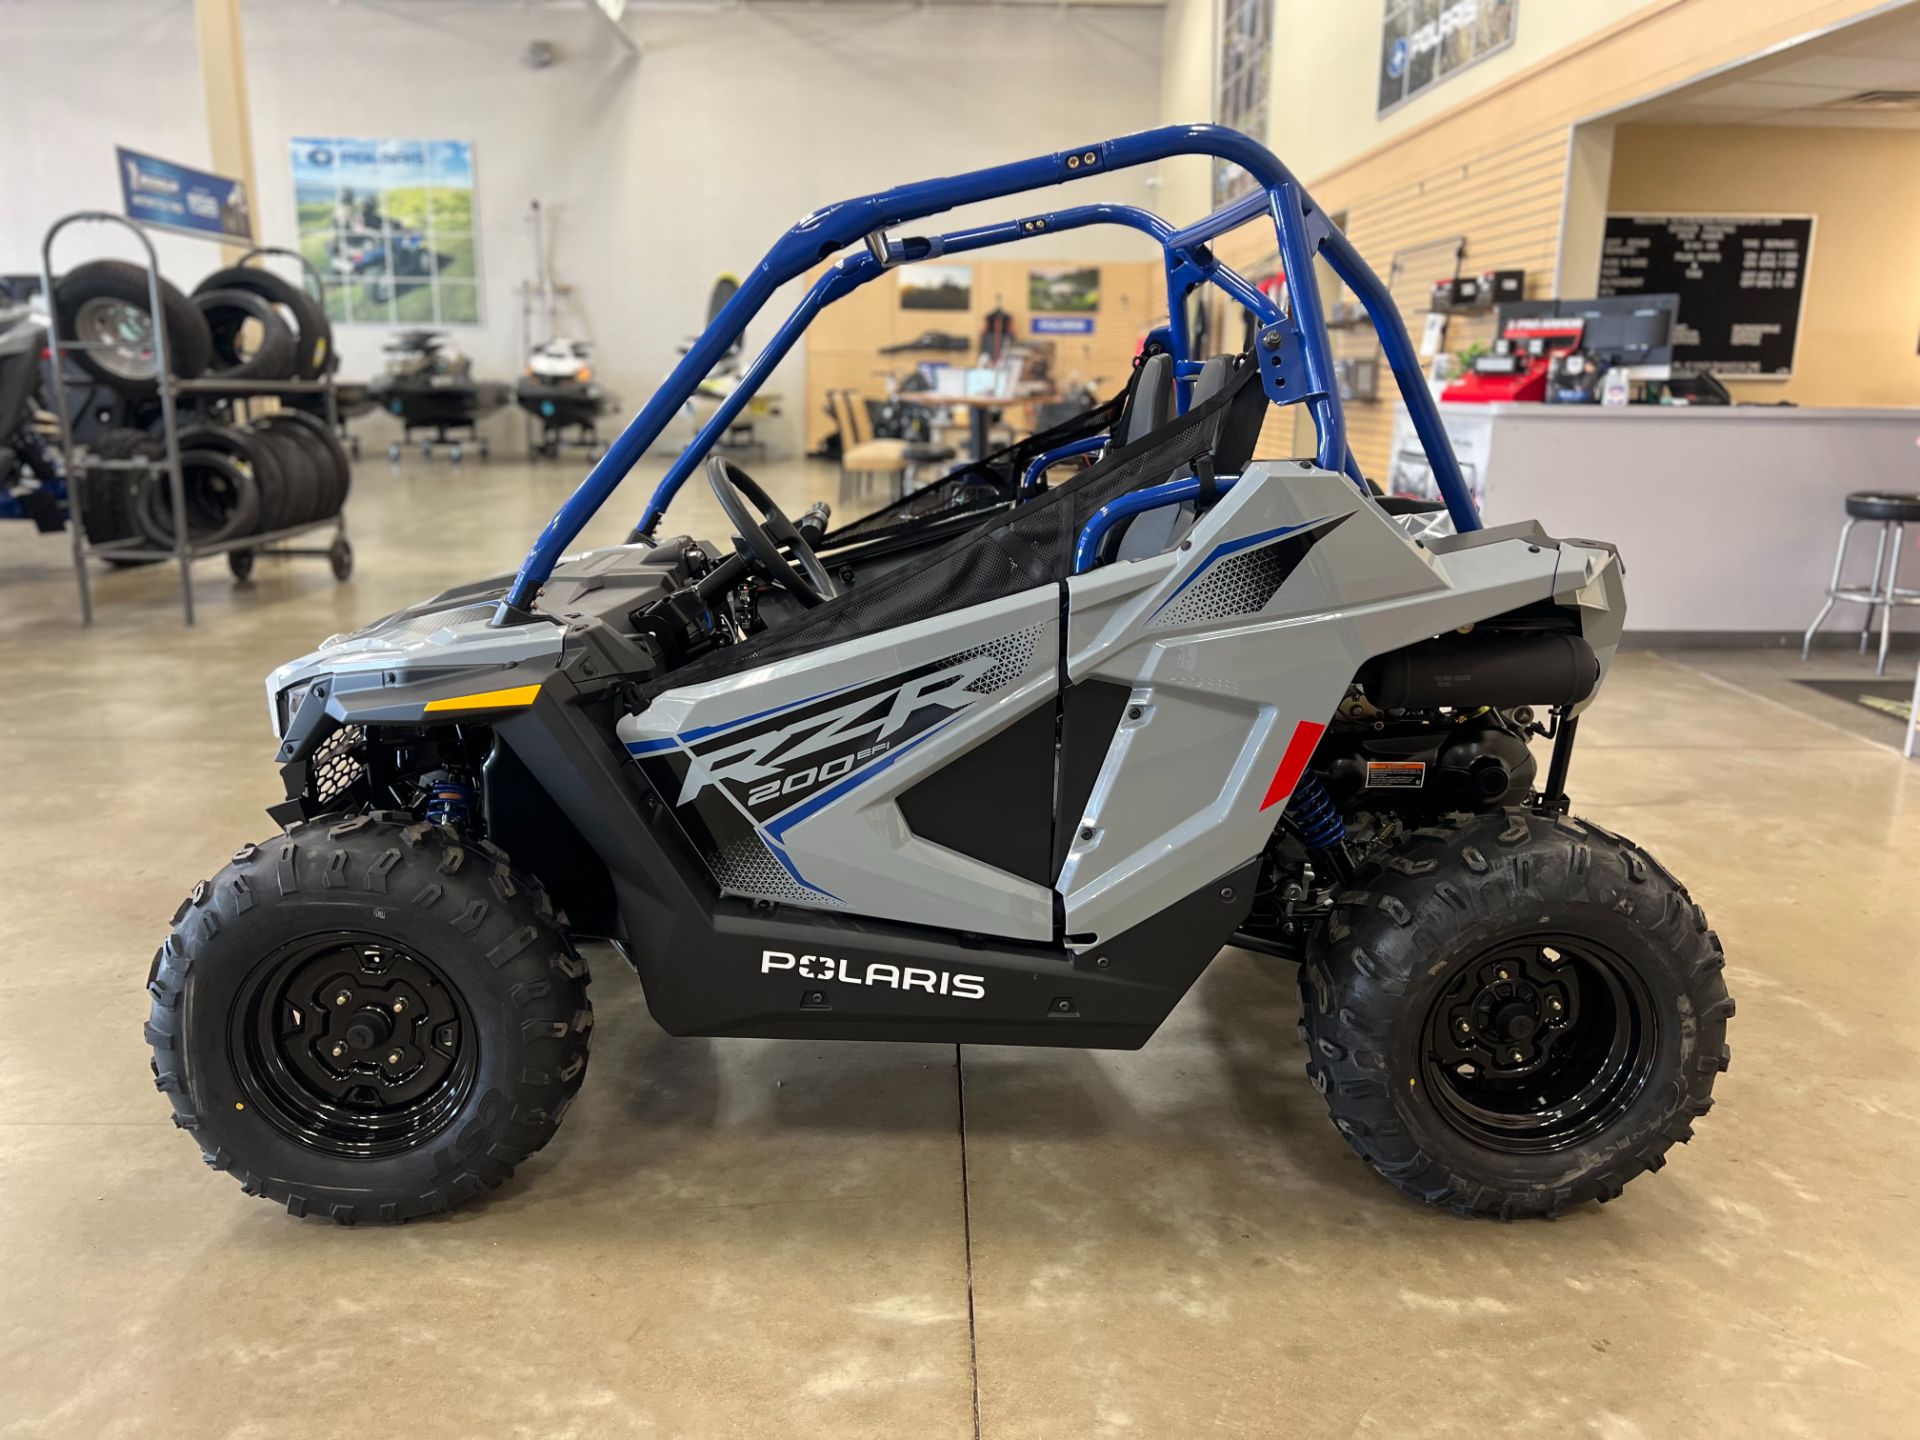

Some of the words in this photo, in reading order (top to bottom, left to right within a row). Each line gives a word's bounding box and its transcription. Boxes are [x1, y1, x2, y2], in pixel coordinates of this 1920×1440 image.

[341, 151, 424, 166] POLARIS
[676, 655, 998, 807] RZR
[748, 754, 855, 806] 200
[856, 742, 890, 760] EFI
[761, 950, 985, 999] POLARIS
